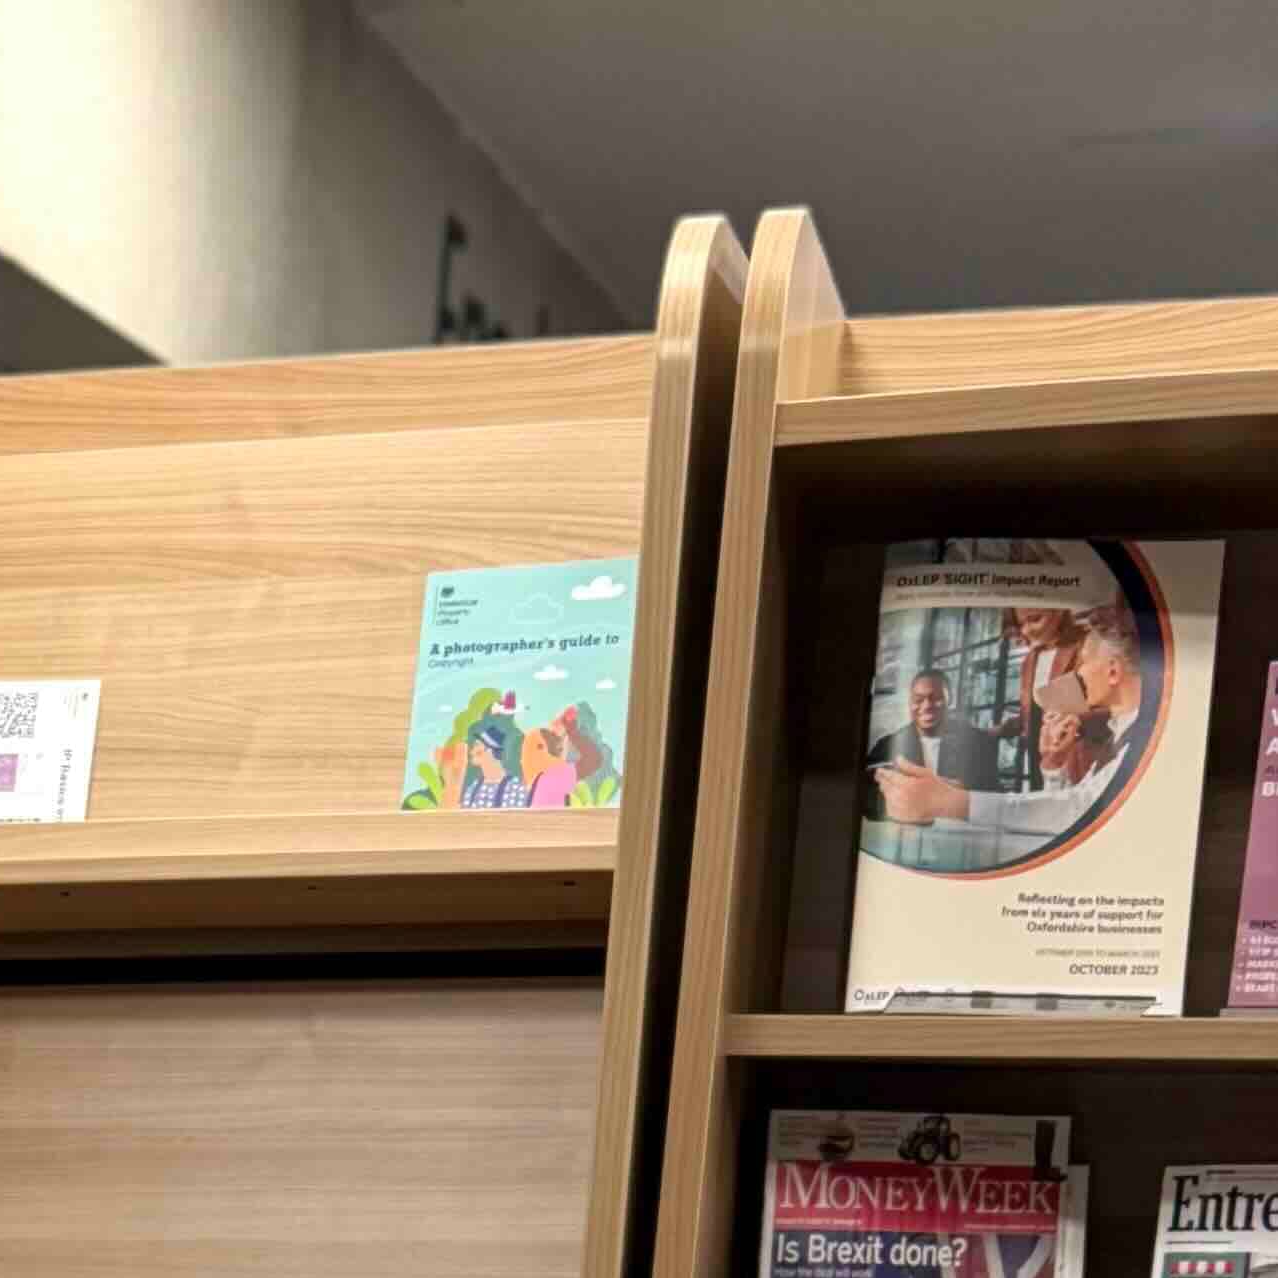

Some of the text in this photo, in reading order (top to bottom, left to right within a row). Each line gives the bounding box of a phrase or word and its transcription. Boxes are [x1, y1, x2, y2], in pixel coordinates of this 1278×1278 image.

[430, 633, 619, 657] A photographer's guide to
[1167, 1175, 1278, 1232] Entre
[777, 1234, 967, 1267] Is Brexit done?
